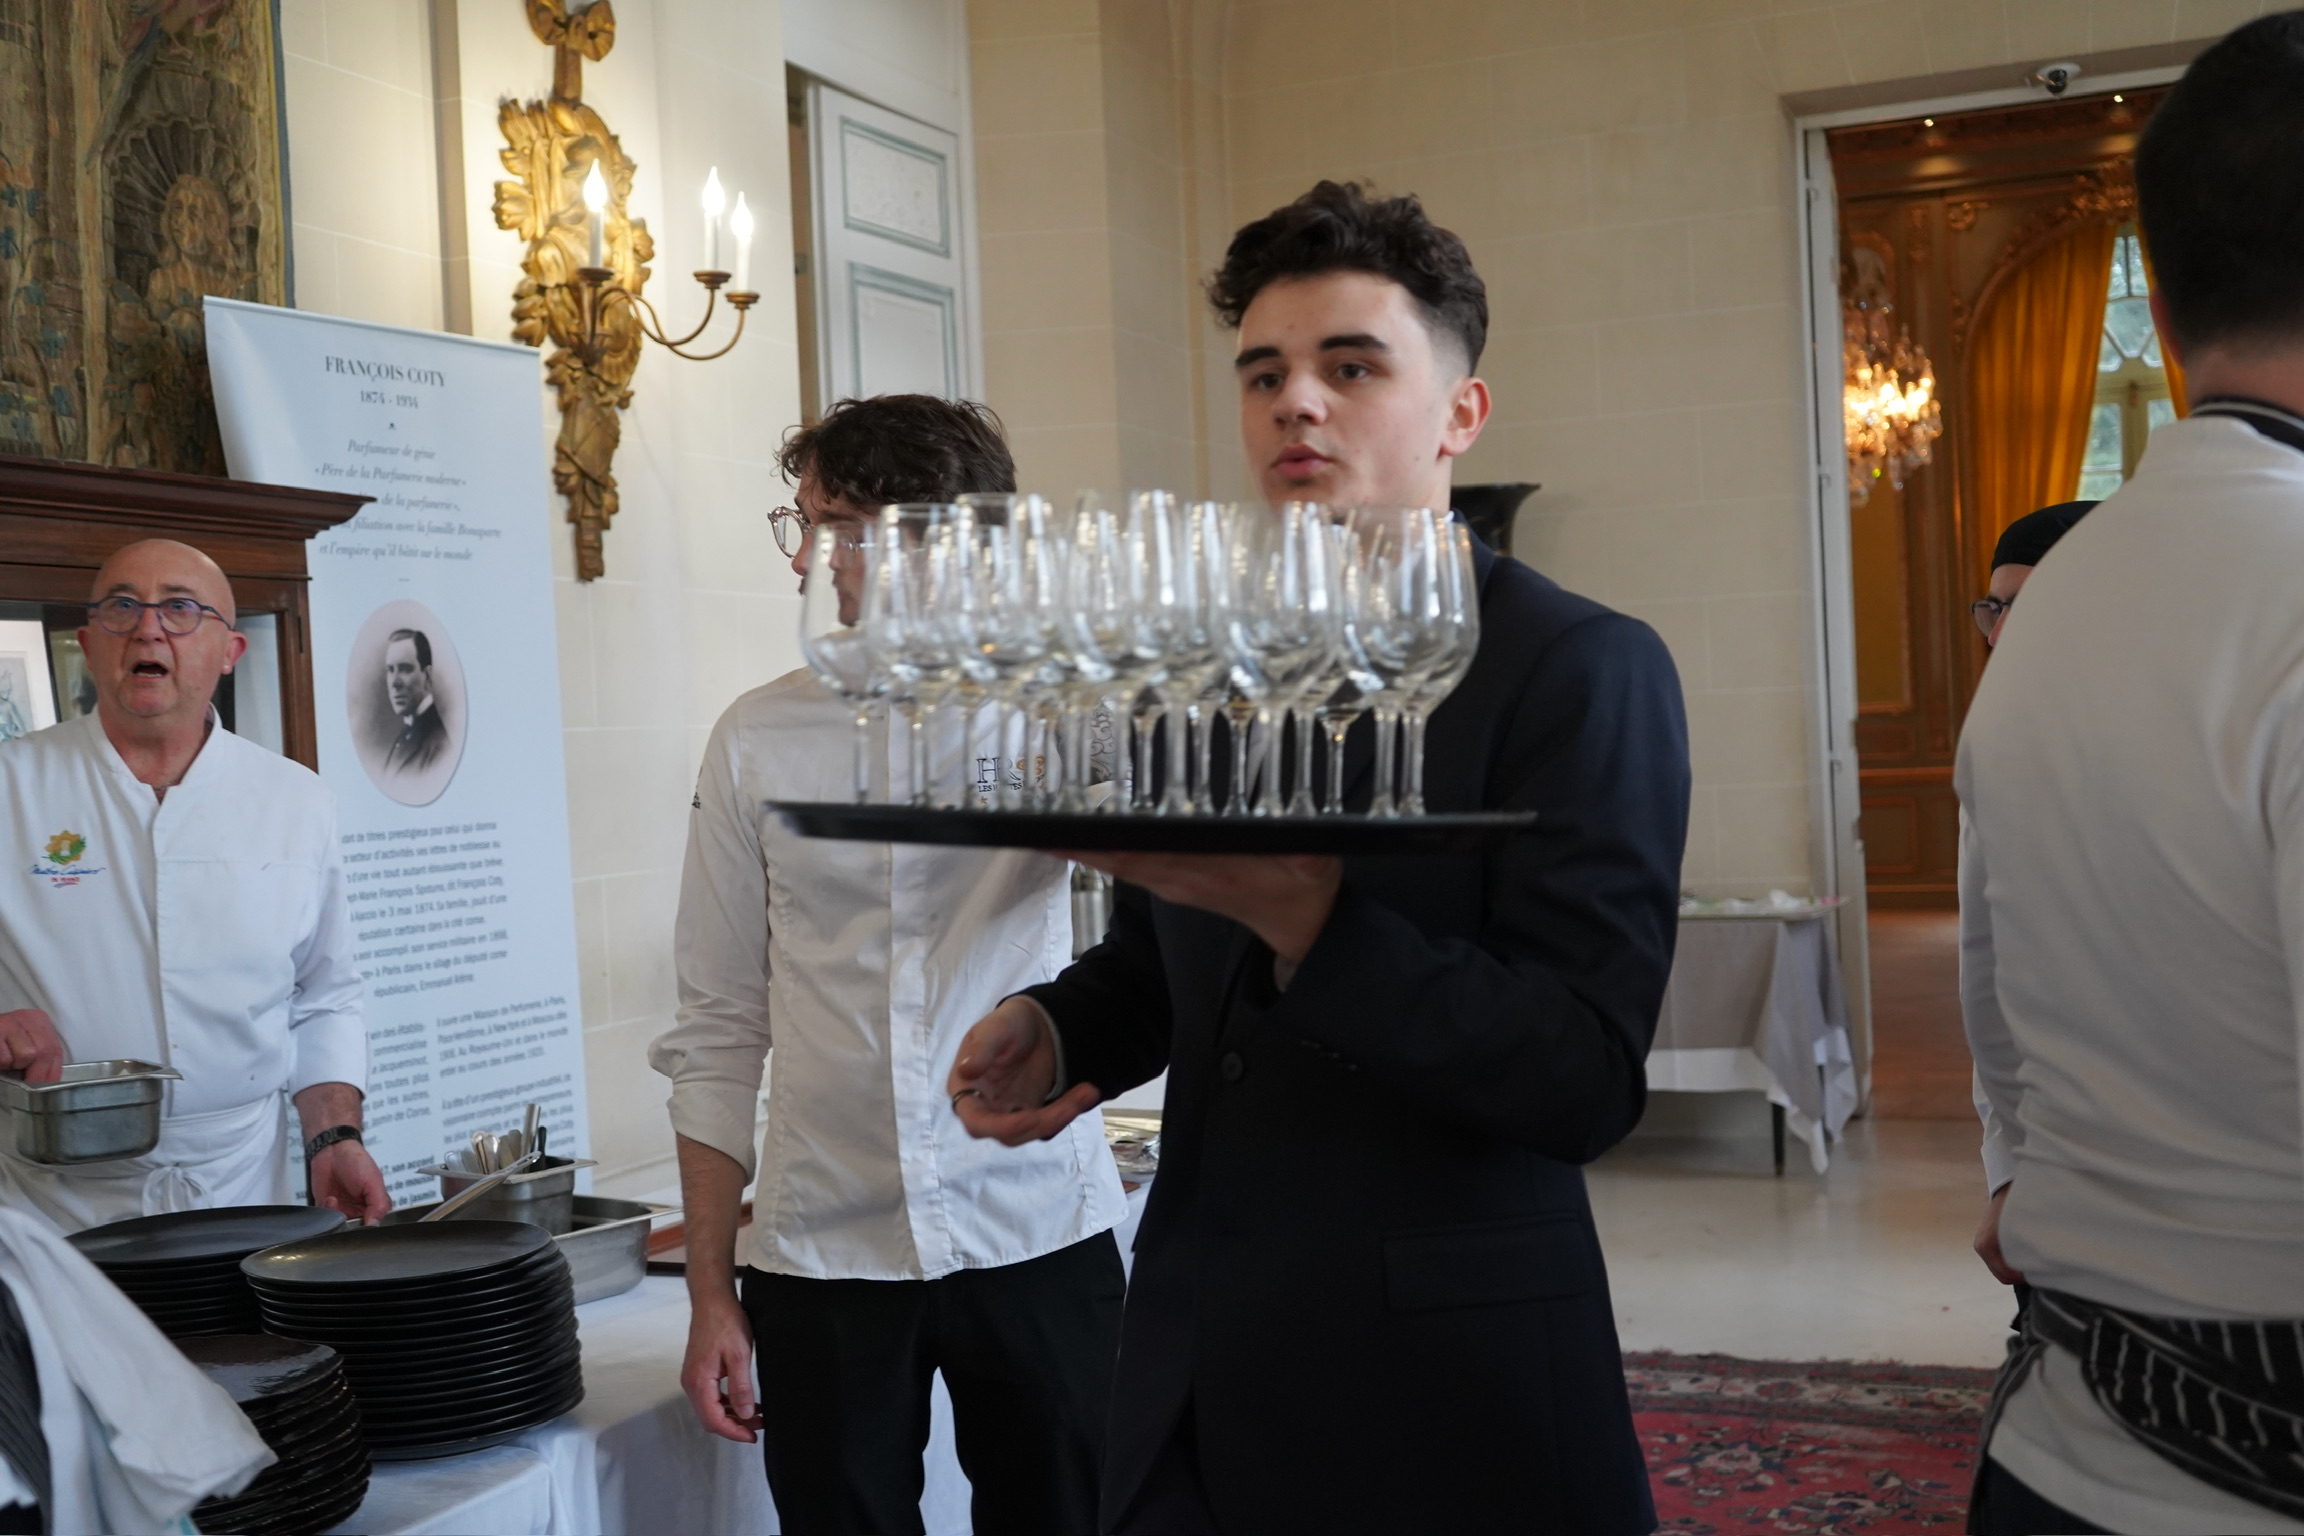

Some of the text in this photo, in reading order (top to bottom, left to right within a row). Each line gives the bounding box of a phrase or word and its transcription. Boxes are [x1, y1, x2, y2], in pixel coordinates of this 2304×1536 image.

[325, 355, 446, 387] FRANÇOIS COTY
[360, 390, 385, 404] 1874
[347, 439, 401, 456] Parfumeur
[401, 444, 412, 456] de
[346, 464, 358, 478] de
[360, 465, 370, 479] la
[373, 466, 424, 484] Parfumerie
[380, 492, 393, 505] de
[396, 493, 405, 506] la
[351, 516, 393, 533] filiation
[417, 519, 425, 532] la
[458, 523, 502, 540] Bonaparte
[443, 548, 472, 561] monde
[978, 784, 992, 793] LES
